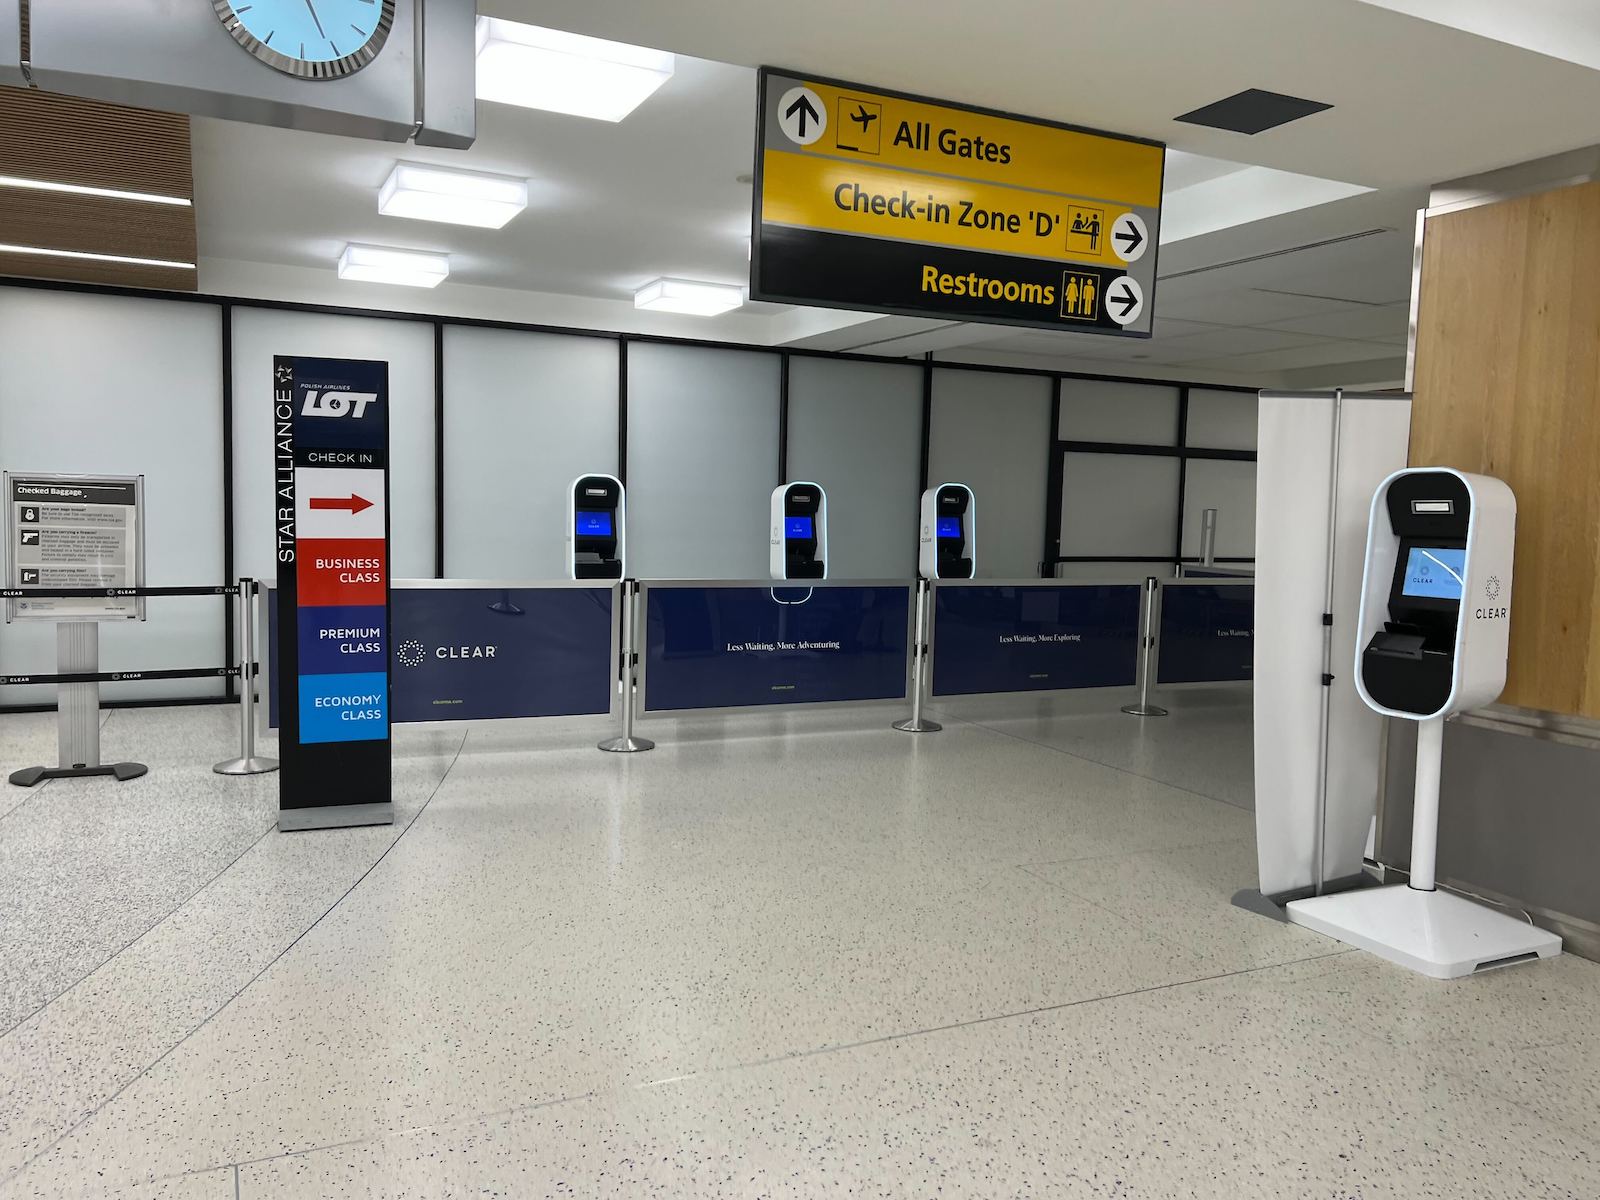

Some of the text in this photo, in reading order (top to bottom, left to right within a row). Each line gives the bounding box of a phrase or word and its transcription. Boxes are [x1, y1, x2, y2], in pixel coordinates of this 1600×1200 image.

[893, 121, 1012, 165] All Gates
[834, 183, 1061, 239] Check-in Zone 'D'
[921, 265, 1055, 306] Restrooms
[300, 390, 378, 418] LOT
[308, 452, 372, 463] CHECK IN
[275, 388, 295, 562] STAR ALLIANCE
[17, 486, 82, 497] Checked Baggage
[316, 558, 380, 569] BUSINESS
[339, 572, 380, 583] CLASS
[1475, 607, 1507, 620] CLEAR
[319, 627, 381, 640] PREMIUM
[1000, 635, 1013, 643] Less
[1038, 634, 1053, 642] More
[1054, 633, 1081, 642] Exploring
[340, 642, 381, 654] CLASS
[435, 645, 496, 659] CLEAR
[727, 643, 744, 651] Less
[777, 641, 796, 649] More
[797, 640, 840, 649] Adventuring
[315, 694, 381, 708] ECONOMY
[341, 709, 382, 721] CLASS
